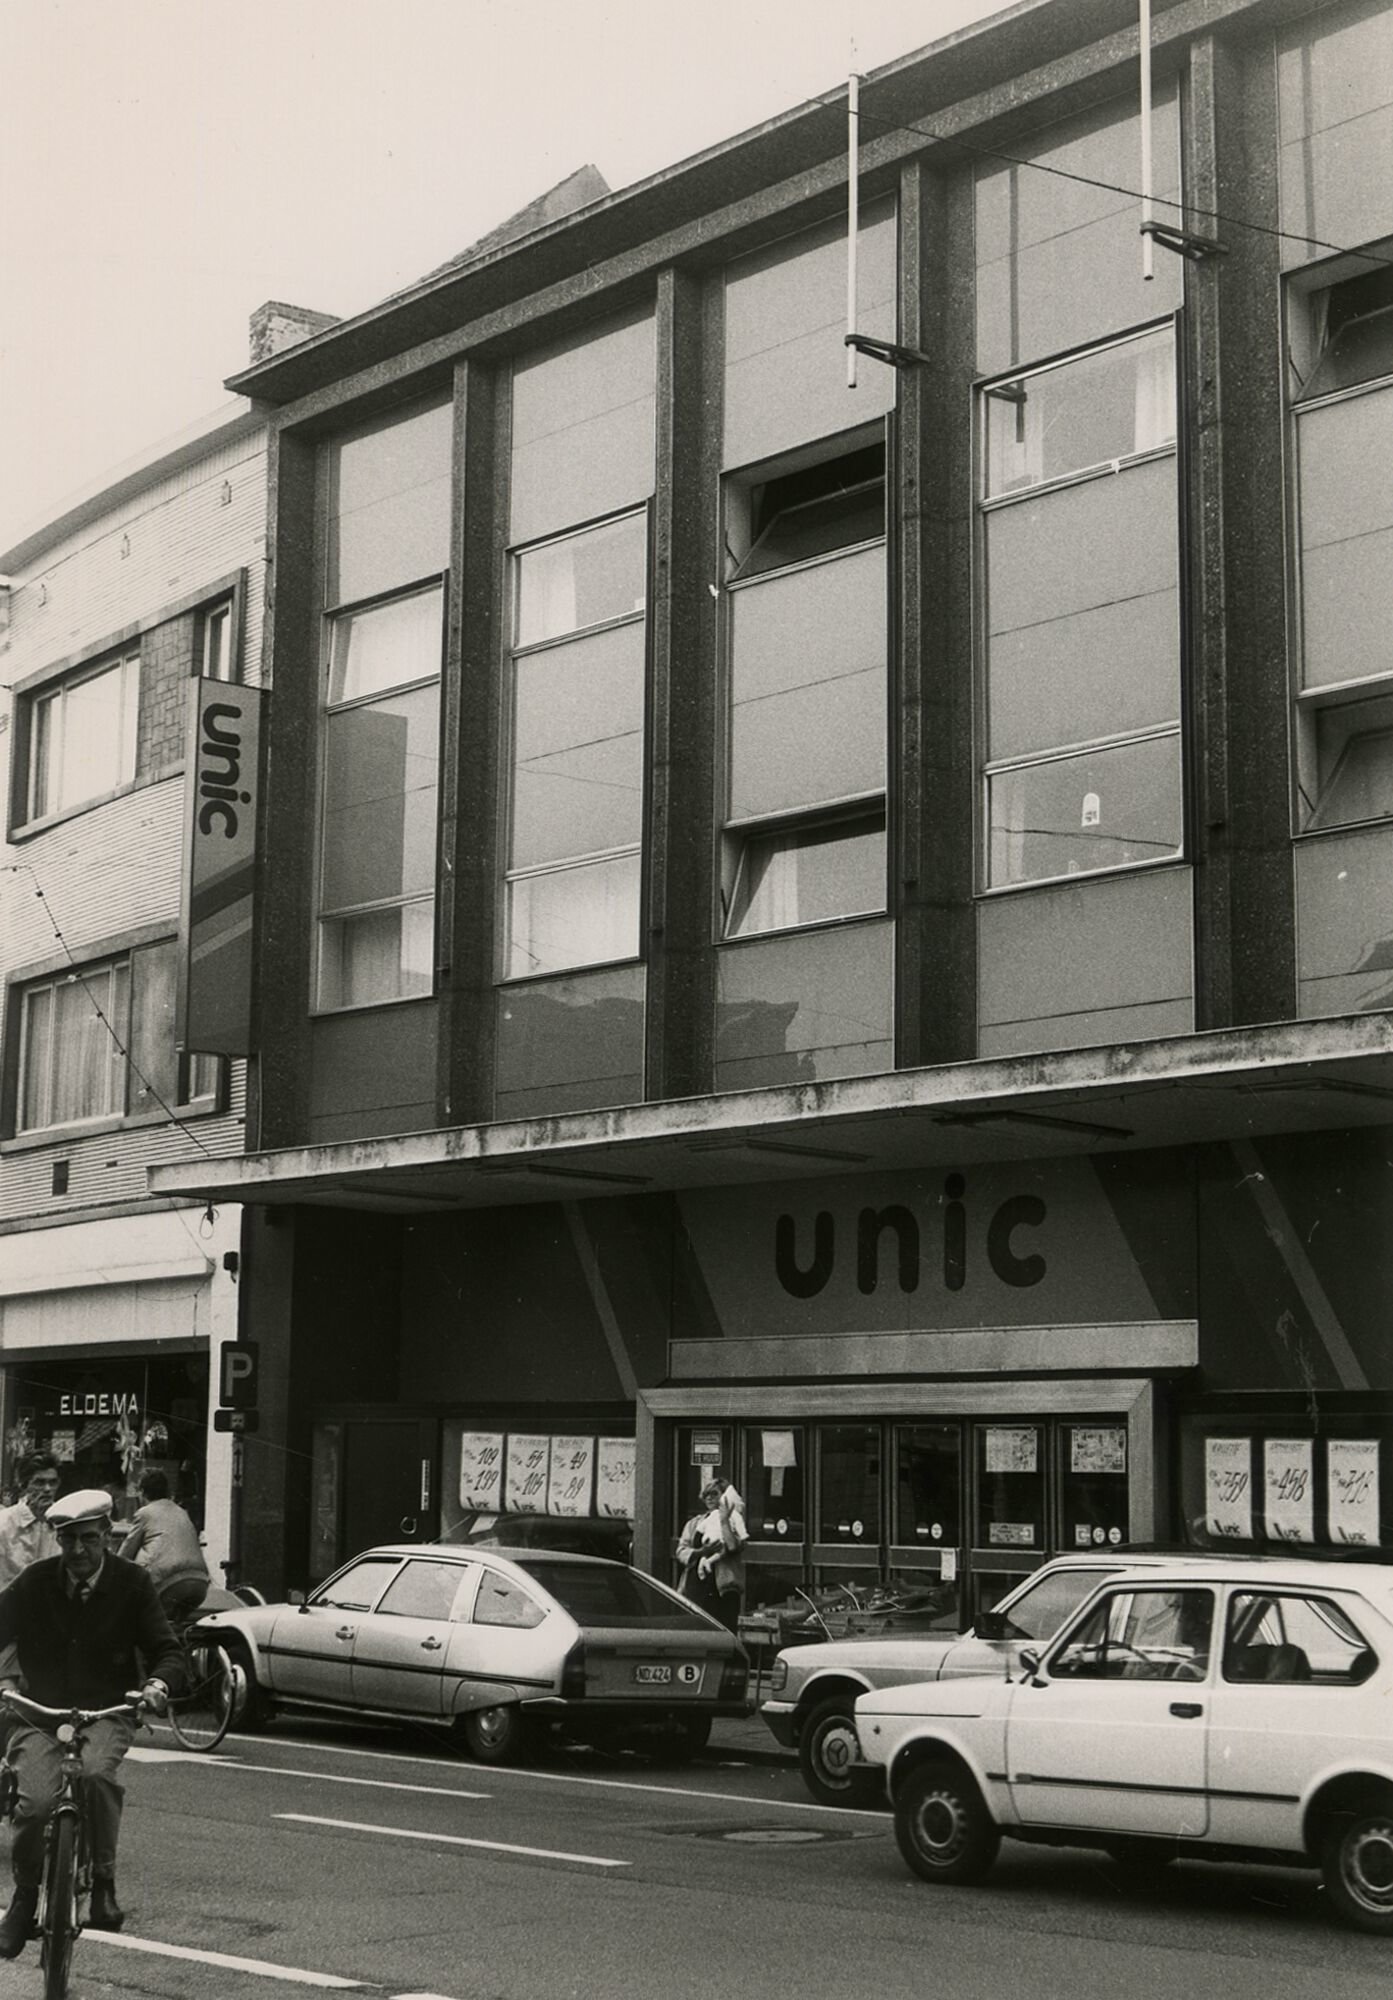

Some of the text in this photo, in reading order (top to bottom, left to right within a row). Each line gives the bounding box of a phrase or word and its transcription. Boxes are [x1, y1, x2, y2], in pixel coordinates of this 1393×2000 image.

[200, 703, 251, 839] unic
[775, 1172, 1047, 1299] unic
[225, 1352, 253, 1398] P
[60, 1393, 139, 1416] ELDEMA
[477, 1447, 499, 1466] 109
[473, 1470, 499, 1491] 199
[1277, 1468, 1308, 1502] 458
[1223, 1522, 1241, 1535] unic
[685, 1666, 695, 1681] B
